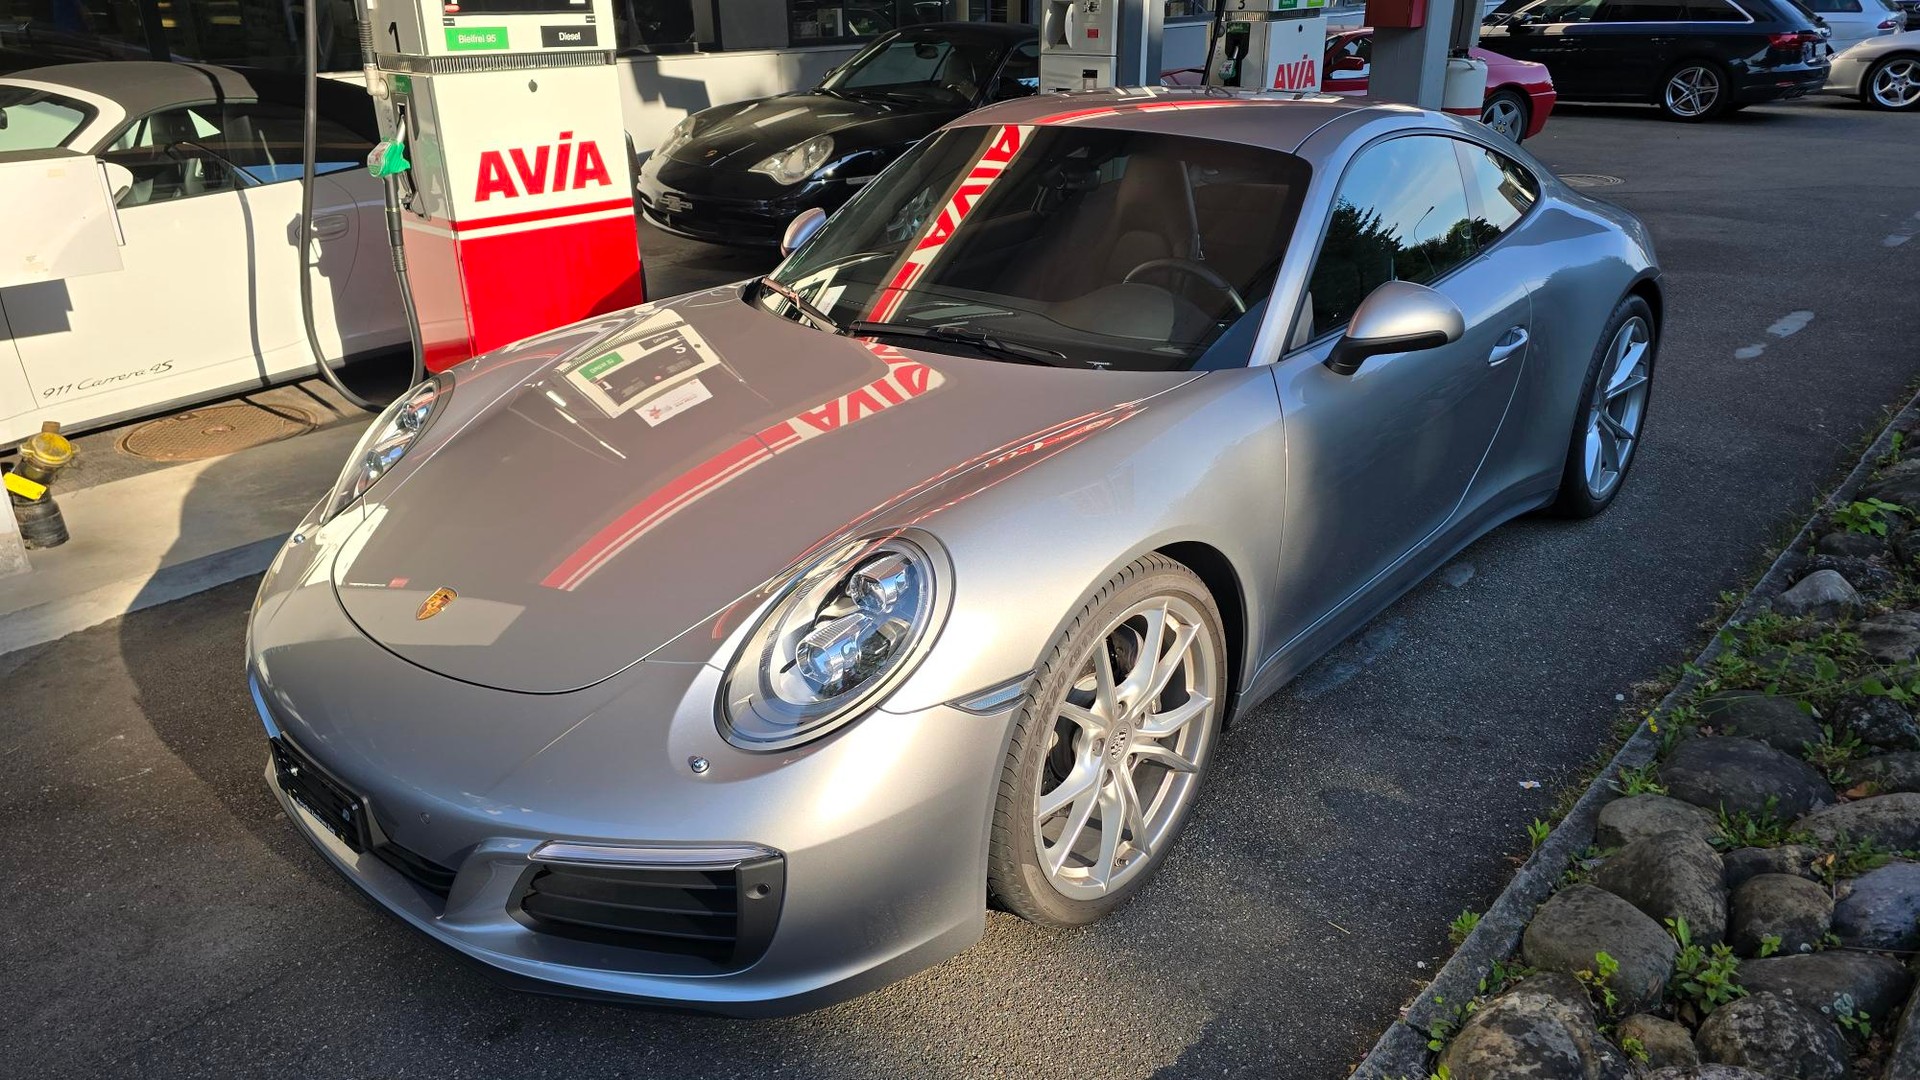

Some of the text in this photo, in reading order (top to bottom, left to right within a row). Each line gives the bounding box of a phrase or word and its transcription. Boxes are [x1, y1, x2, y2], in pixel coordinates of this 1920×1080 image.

[388, 21, 401, 52] 1
[486, 33, 497, 43] 95
[558, 31, 581, 42] Diesel
[43, 359, 174, 399] 911 Carrera 4S
